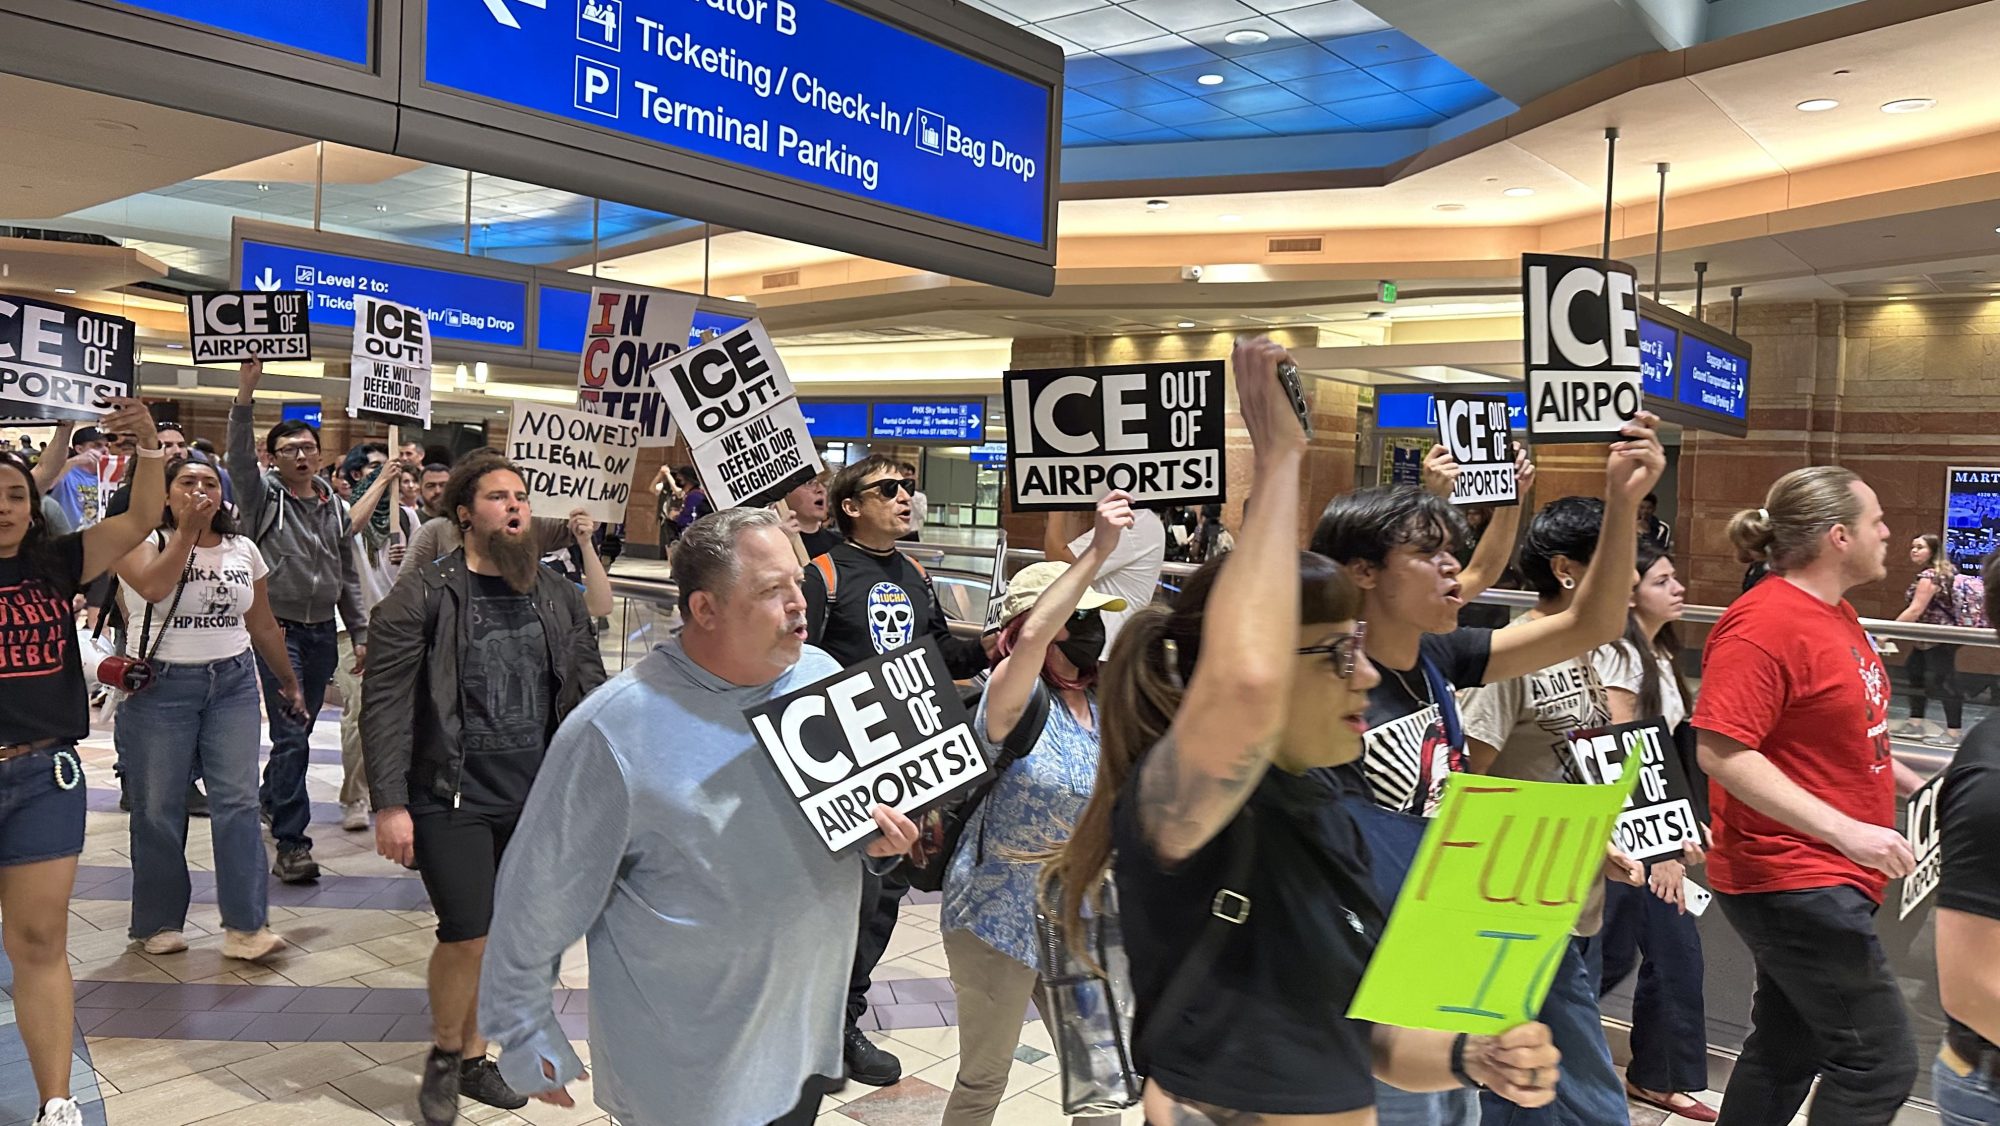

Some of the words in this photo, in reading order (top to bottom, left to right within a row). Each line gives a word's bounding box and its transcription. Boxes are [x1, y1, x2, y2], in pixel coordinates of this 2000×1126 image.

[776, 0, 797, 36] B
[634, 81, 768, 153] Terminal
[778, 125, 879, 190] Parking
[946, 124, 986, 168] Bag
[991, 140, 1036, 183] Drop
[318, 271, 355, 288] Level
[358, 277, 368, 290] 2
[371, 278, 389, 293] to:
[77, 316, 123, 350] OUT
[191, 294, 275, 335] ICE
[274, 294, 302, 314] OUT
[279, 313, 295, 333] OF
[366, 300, 423, 345] ICE
[461, 314, 484, 330] Bag
[487, 317, 515, 332] Drop
[592, 293, 649, 336] IN
[1528, 265, 1641, 367] ICE
[84, 346, 114, 376] OF
[197, 337, 305, 357] AIRPORTS!
[365, 338, 423, 364] OUT!
[364, 376, 402, 396] DEFEND
[404, 384, 421, 401] OUR
[373, 362, 390, 379] WE
[393, 363, 413, 384] WILL
[670, 330, 770, 411] ICE
[363, 393, 419, 416] NEIGHBORS!
[696, 374, 780, 433] OUT!
[1010, 373, 1149, 454] ICE
[1160, 370, 1211, 410] OUT
[1536, 381, 1641, 422] AIRPO
[519, 410, 565, 441] NO
[720, 430, 747, 456] WE
[744, 414, 778, 444] WILL
[1170, 410, 1203, 448] OF
[1437, 399, 1487, 463] ICE
[1488, 401, 1507, 431] OUT
[512, 442, 601, 470] ILLEGAL
[604, 455, 630, 475] ON
[717, 442, 771, 483] DEFEND
[769, 427, 797, 455] OUR
[1493, 432, 1507, 461] OF
[520, 466, 588, 498] TOLEN
[727, 446, 804, 502] NEIGHBORS!
[1020, 456, 1213, 497] AIRPORTS!
[1453, 468, 1513, 498] IRPORTS!
[752, 671, 902, 799] ICE
[881, 647, 936, 701] OUT
[907, 689, 943, 736] OF
[1621, 726, 1665, 764] OUT
[816, 733, 977, 842] AIRPORTS!
[1639, 763, 1668, 802] OF
[1616, 807, 1693, 853] ORTS!
